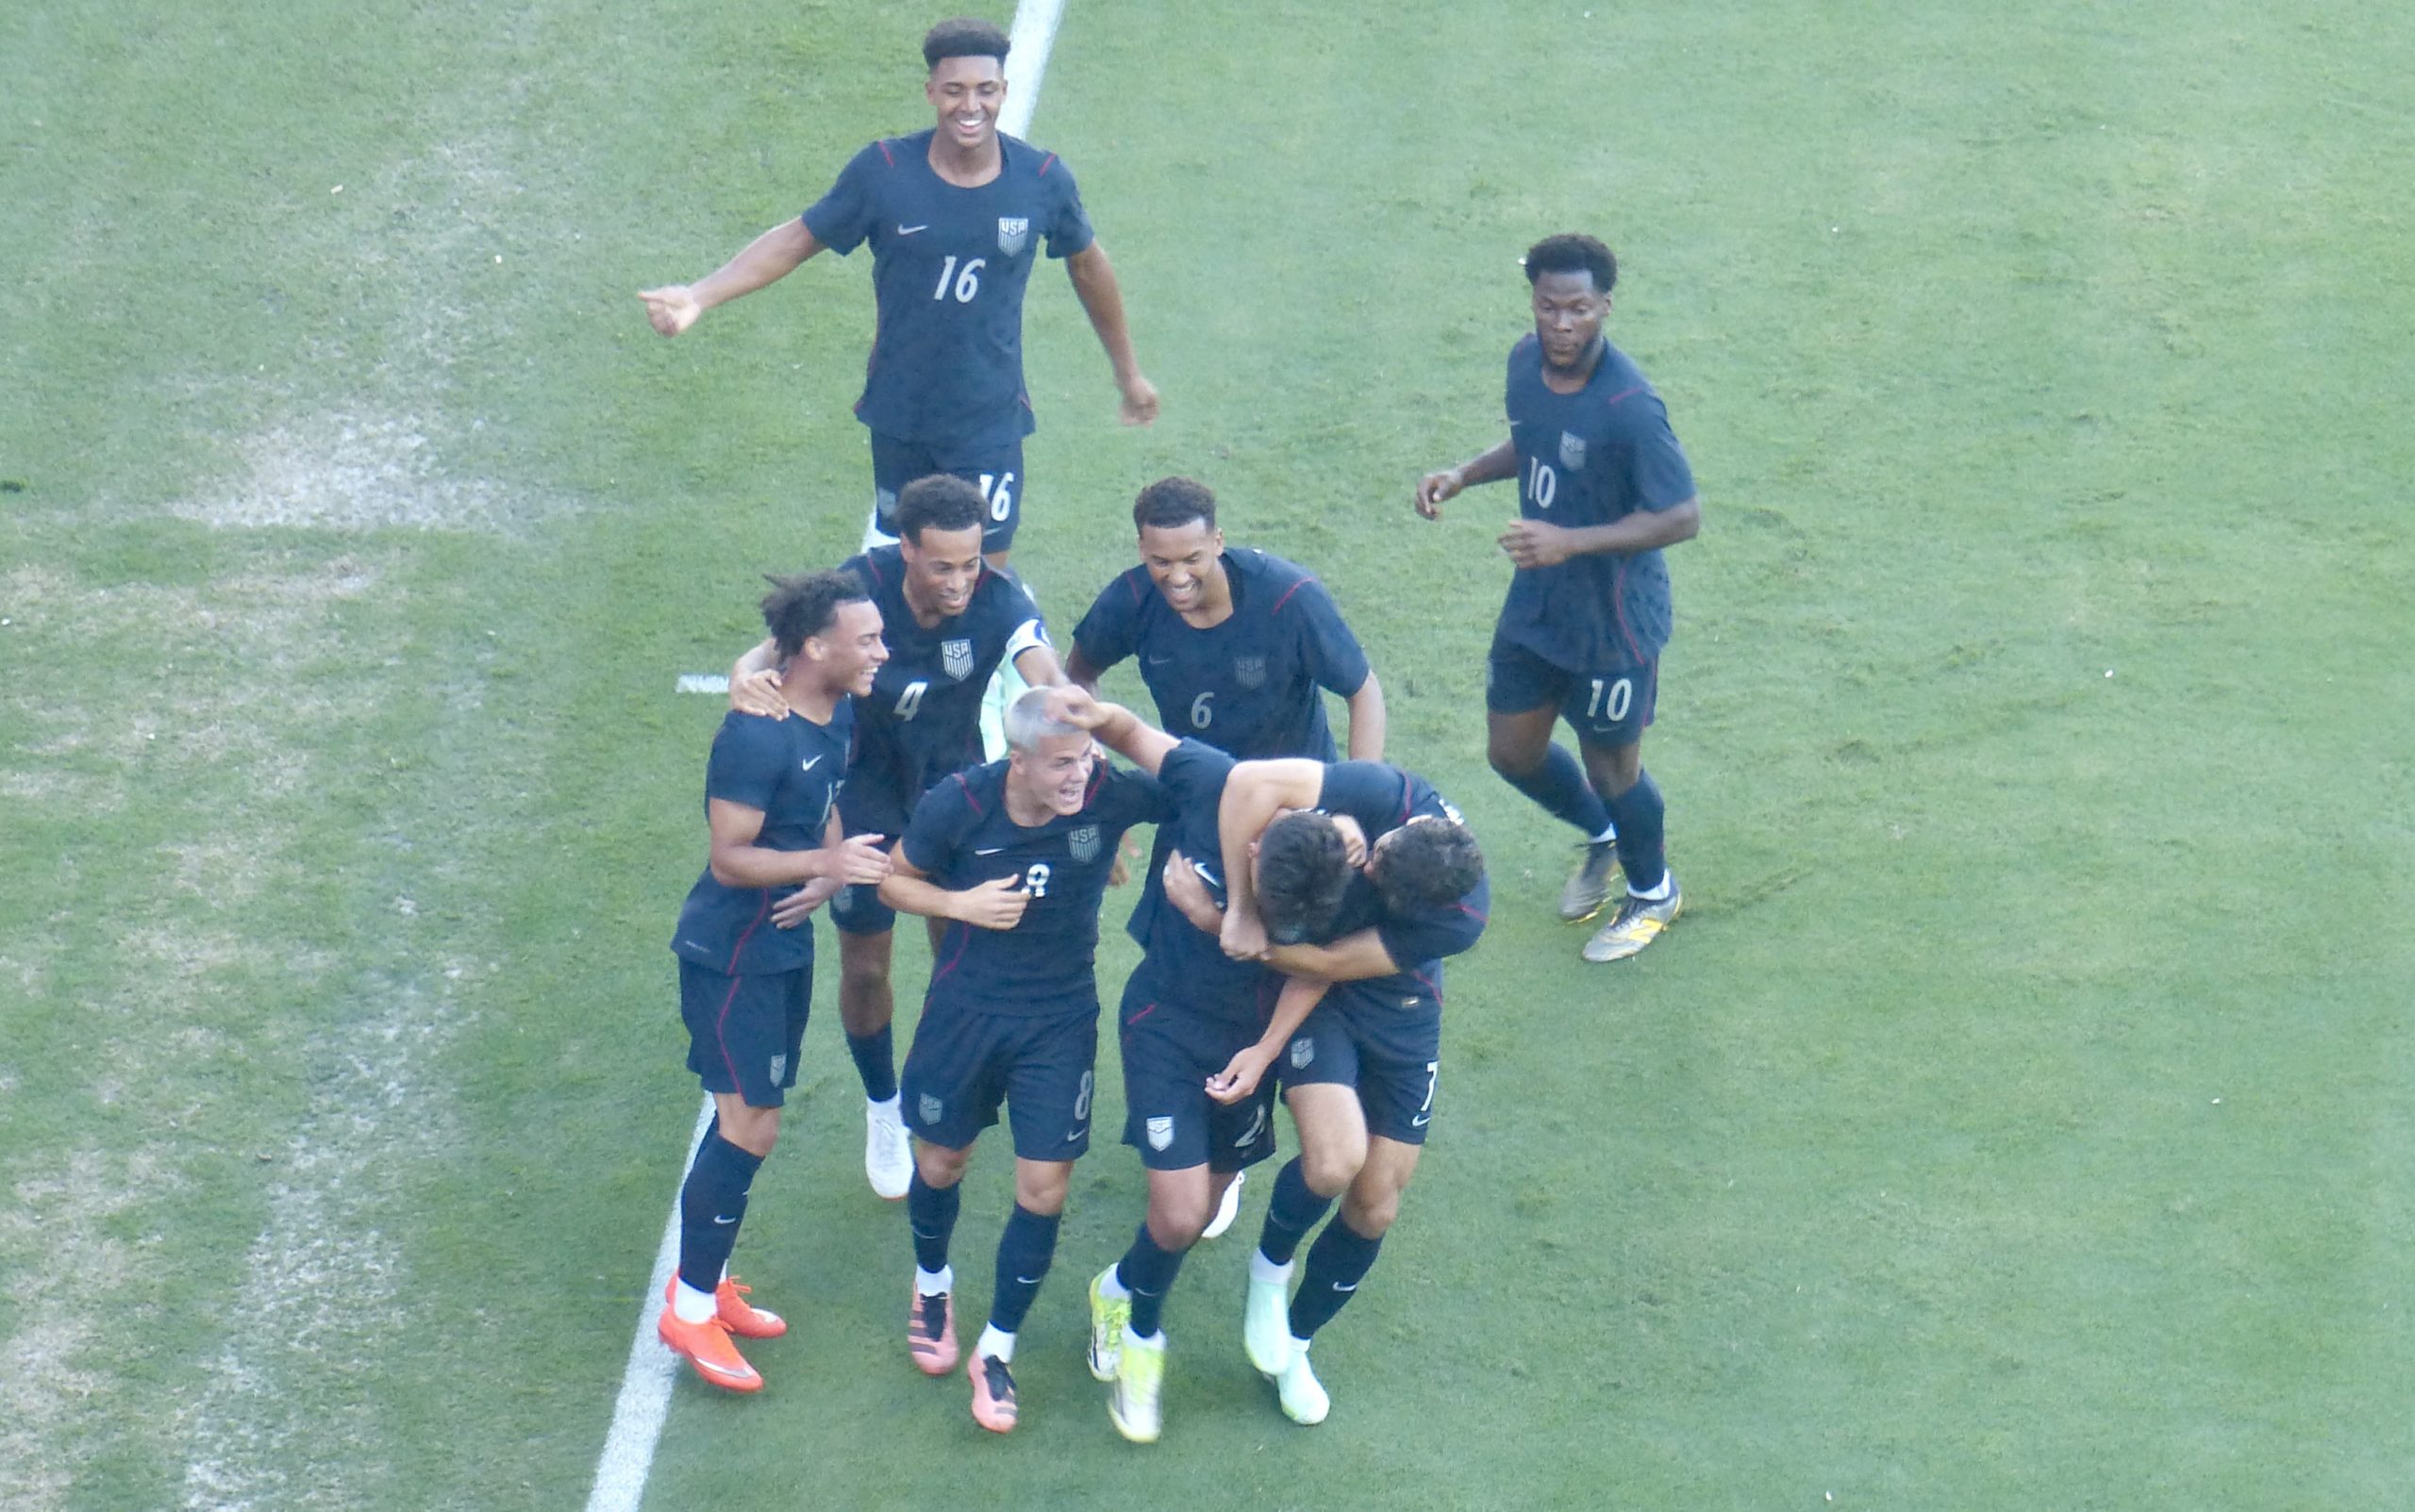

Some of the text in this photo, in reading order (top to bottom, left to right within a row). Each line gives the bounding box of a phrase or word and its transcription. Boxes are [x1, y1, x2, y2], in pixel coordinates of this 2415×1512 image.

[1001, 221, 1025, 236] USA
[934, 256, 986, 303] 16
[979, 473, 1014, 522] 16
[1527, 457, 1557, 508] 10
[944, 642, 968, 658] USA
[893, 681, 929, 721] 4
[1191, 691, 1215, 729] 6
[1587, 678, 1633, 722] 10
[1070, 827, 1096, 842] USA
[1074, 1070, 1092, 1121] 8
[1421, 1061, 1439, 1111] 7
